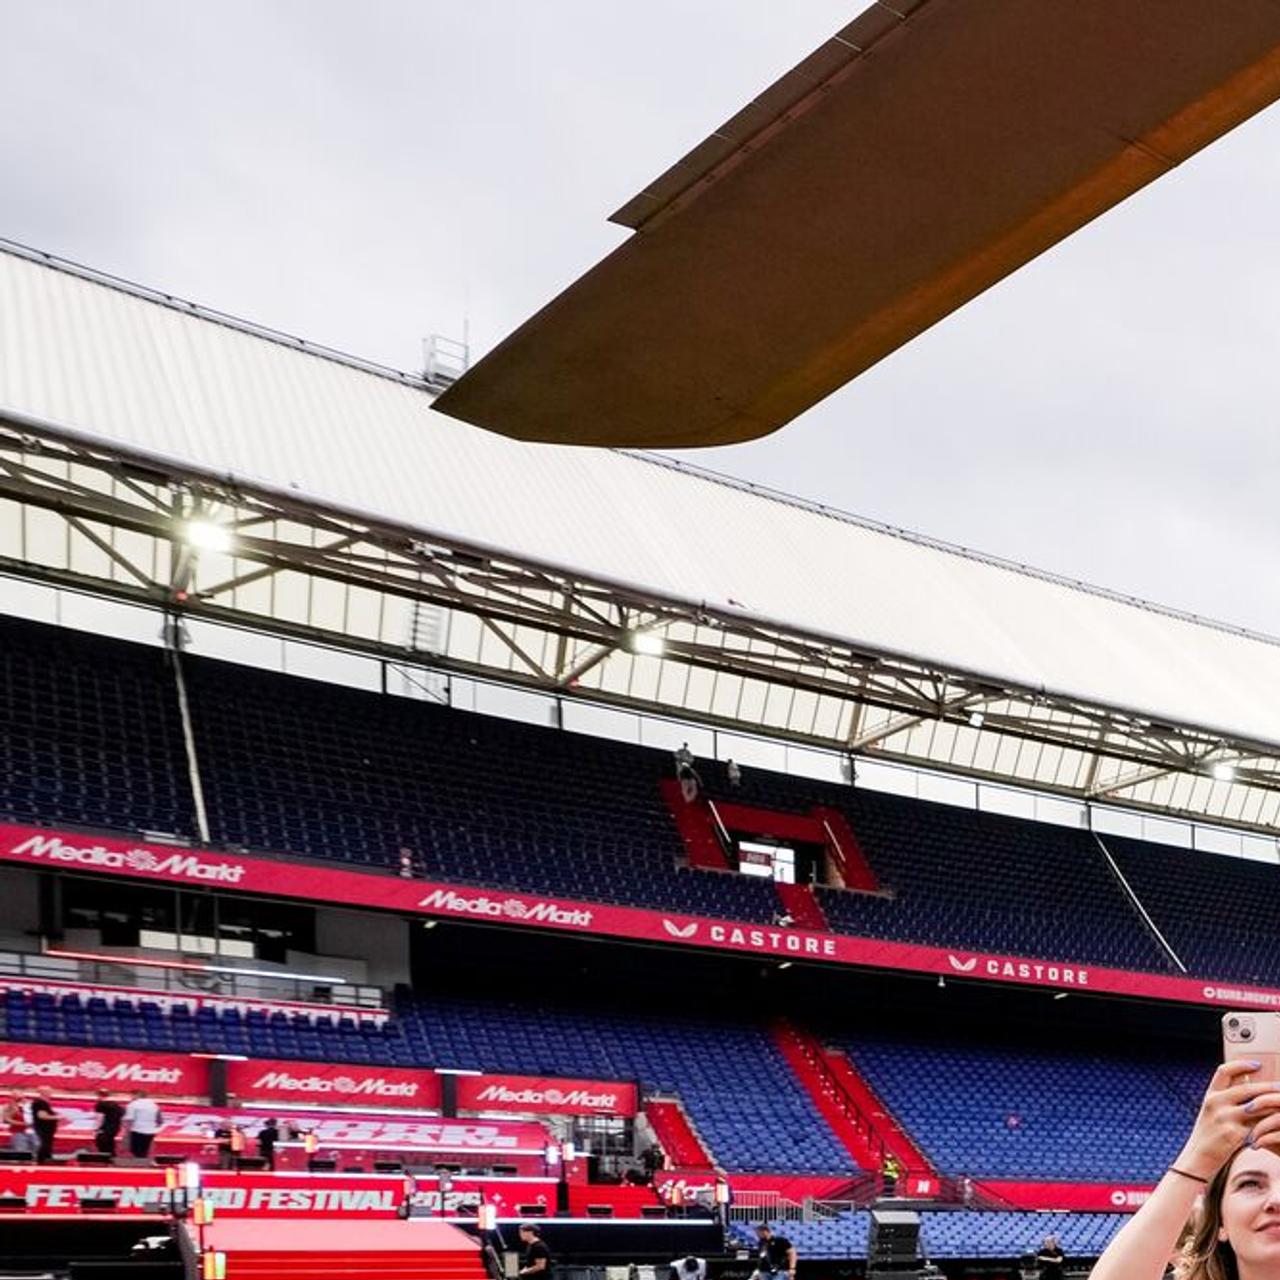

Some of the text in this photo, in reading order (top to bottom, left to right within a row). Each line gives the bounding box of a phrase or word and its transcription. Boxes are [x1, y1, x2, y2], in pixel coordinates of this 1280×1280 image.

[711, 925, 836, 956] CASTORE
[987, 960, 1088, 985] CASTORE
[249, 1188, 397, 1210] FESTIVAL
